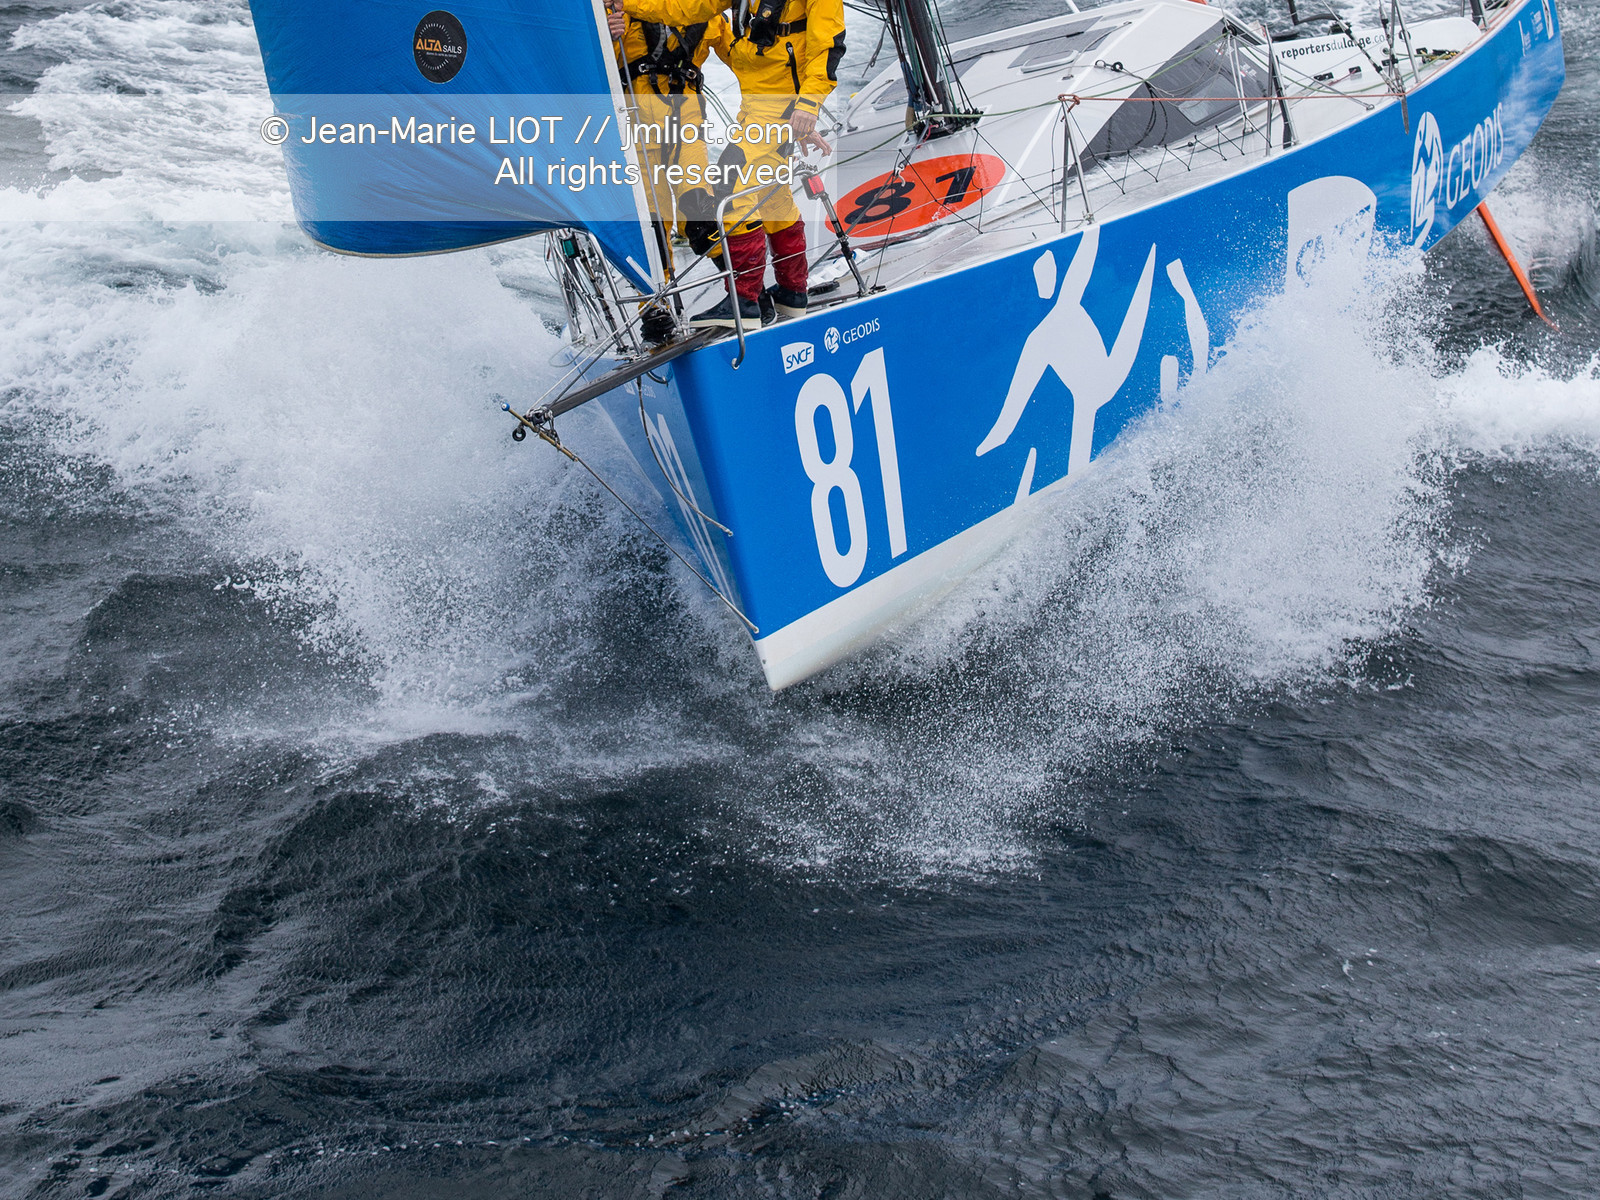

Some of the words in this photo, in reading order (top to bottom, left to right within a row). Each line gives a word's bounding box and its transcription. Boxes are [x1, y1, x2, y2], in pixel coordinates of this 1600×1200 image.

[415, 38, 443, 52] ALTA
[442, 44, 463, 55] SAILS
[1281, 34, 1385, 60] reportersdulage.co
[1446, 102, 1504, 210] GEODIS
[844, 166, 977, 224] 81
[786, 347, 812, 369] SNCF
[843, 318, 880, 344] GEODIS
[794, 347, 908, 588] 81
